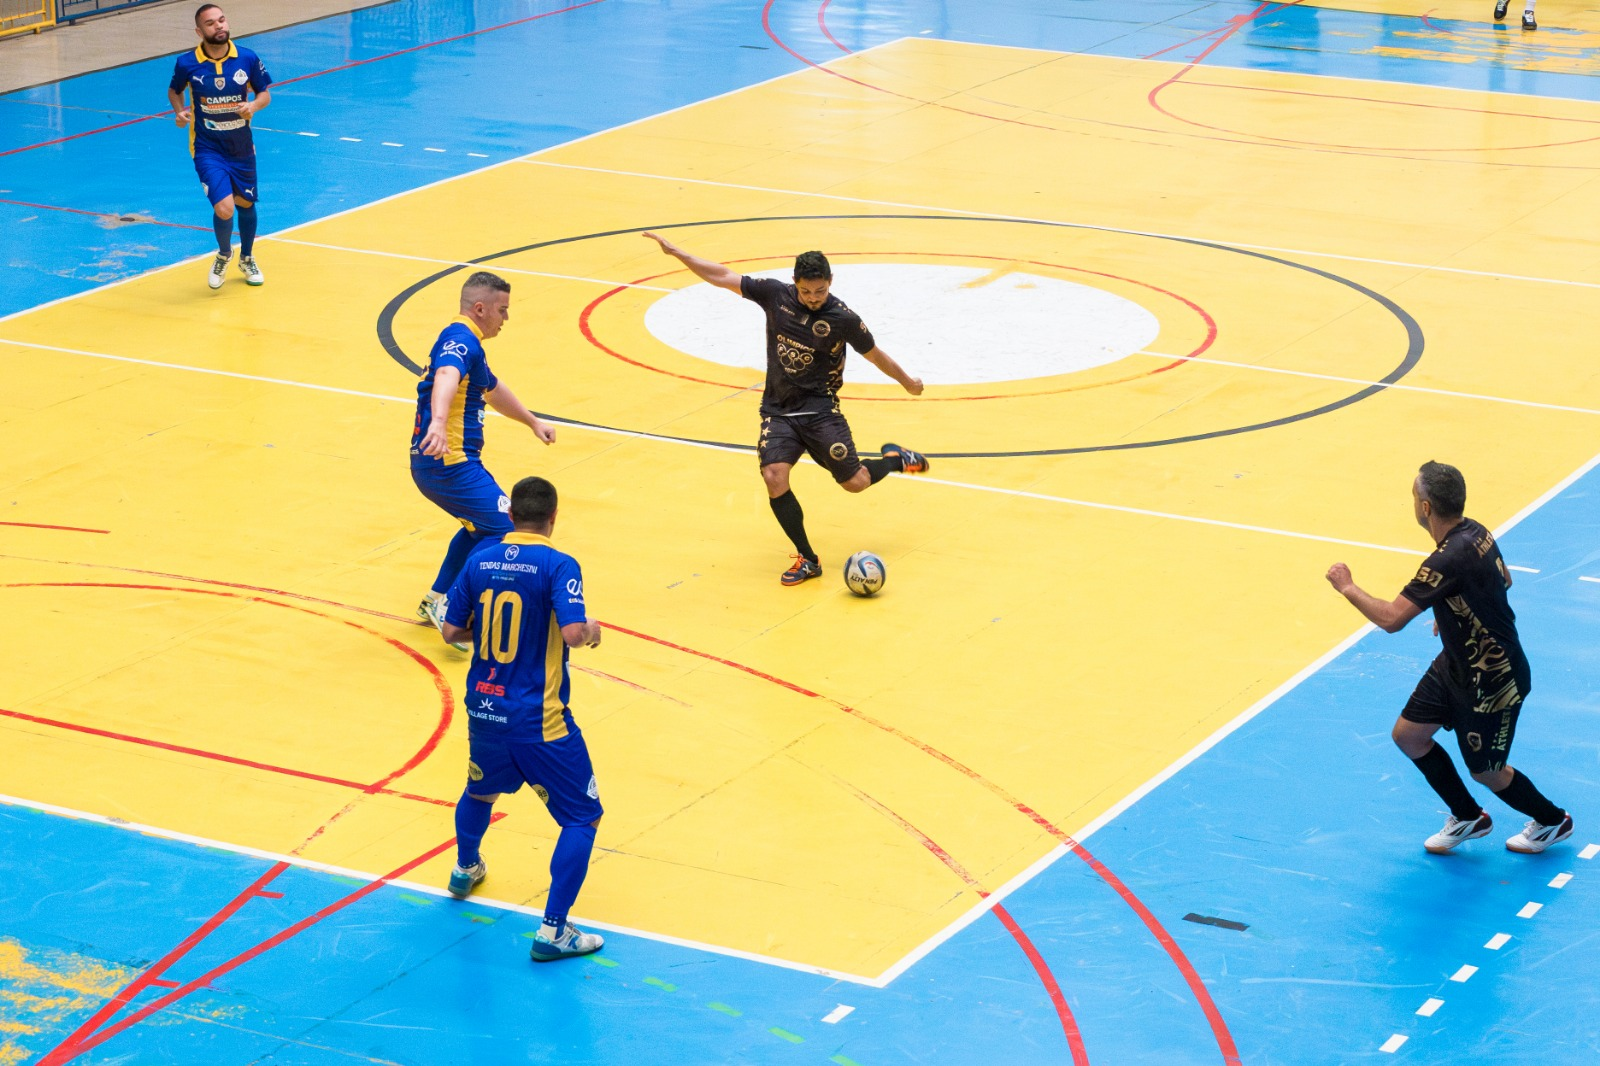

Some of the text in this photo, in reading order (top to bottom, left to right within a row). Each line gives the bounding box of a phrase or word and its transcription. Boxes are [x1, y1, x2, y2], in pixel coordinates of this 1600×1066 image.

[207, 95, 241, 104] CAMPOS
[479, 588, 523, 664] 10
[488, 714, 508, 724] STORE
